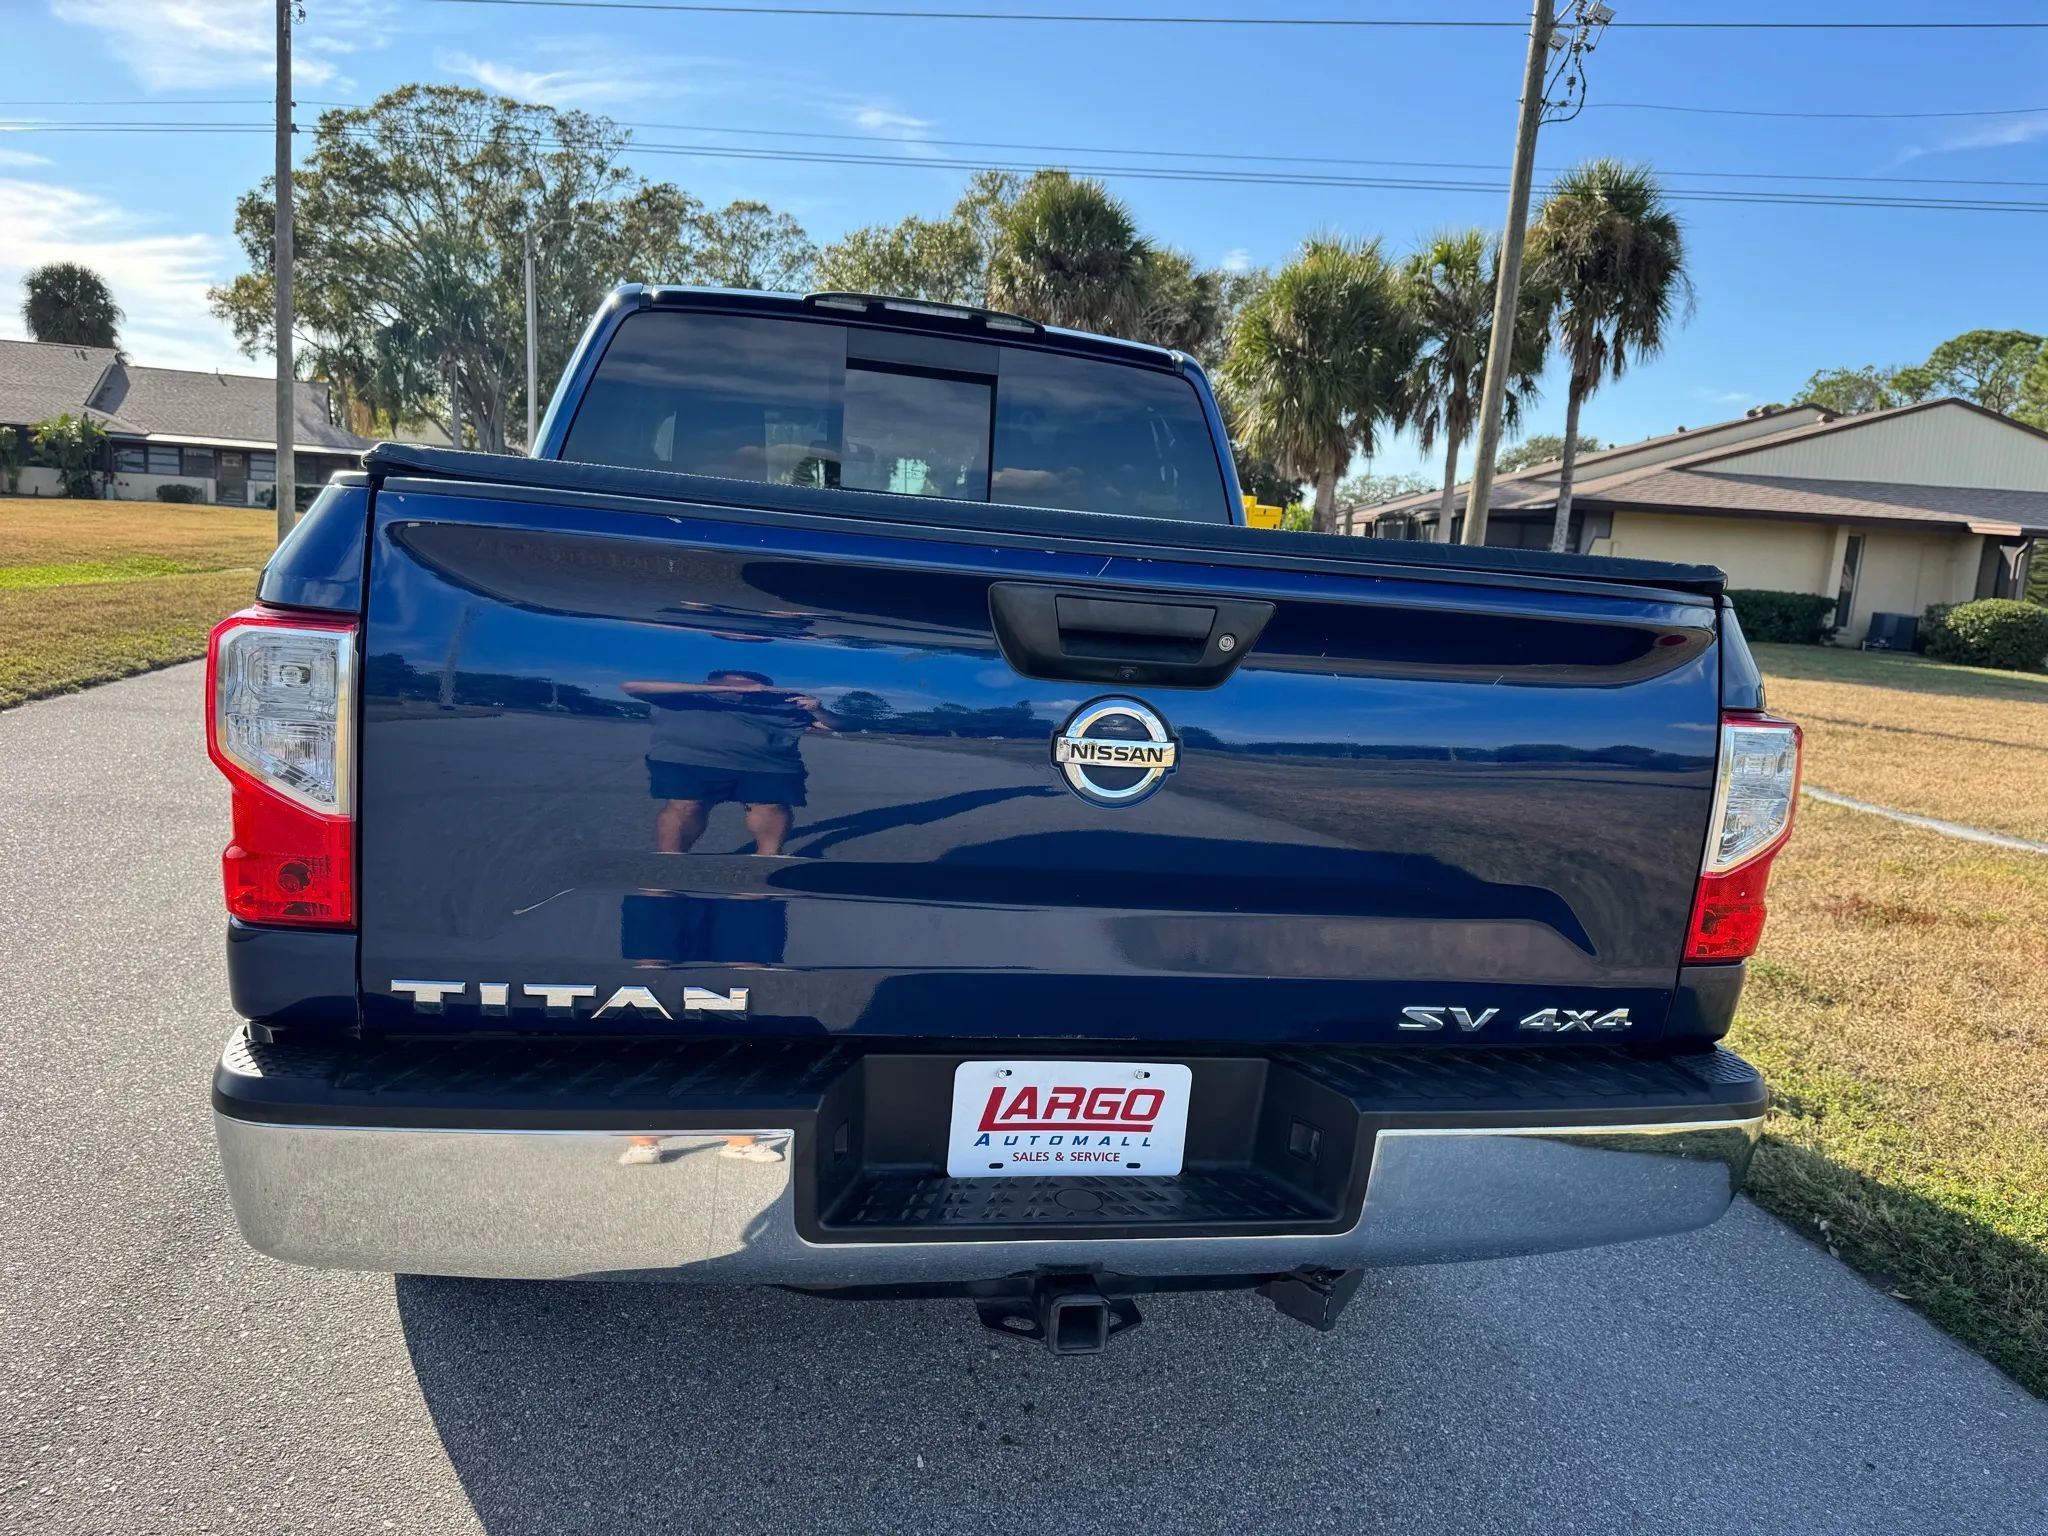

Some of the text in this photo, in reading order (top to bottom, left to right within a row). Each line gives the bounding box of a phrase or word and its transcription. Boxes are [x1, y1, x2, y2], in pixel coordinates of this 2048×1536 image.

[1070, 743, 1163, 762] NISSAN
[391, 979, 750, 1020] TITAN
[1398, 1006, 1500, 1032] SV
[977, 1086, 1166, 1132] LARGO
[974, 1133, 1151, 1147] AUTOMALL
[1012, 1152, 1121, 1162] SALES & SERVICE
